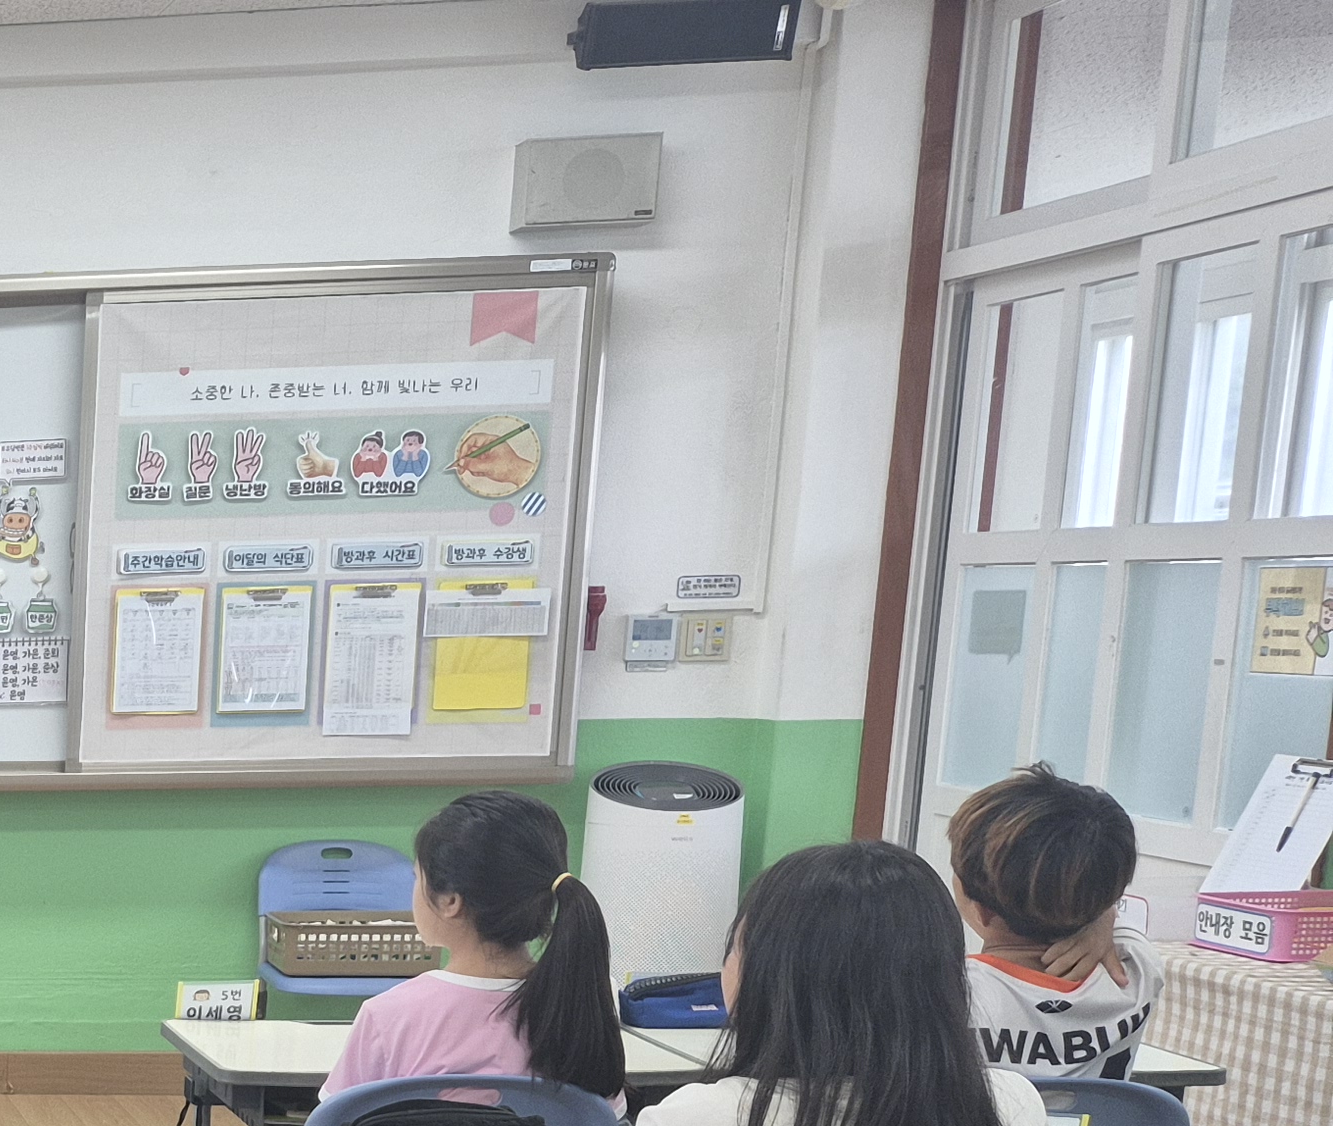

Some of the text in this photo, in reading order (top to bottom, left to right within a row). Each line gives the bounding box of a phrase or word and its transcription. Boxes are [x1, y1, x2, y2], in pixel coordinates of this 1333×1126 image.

[190, 384, 233, 402] 소중한
[268, 381, 325, 399] 존중받는
[360, 379, 389, 396] 함께
[397, 377, 441, 395] 빛나는
[450, 376, 478, 393] 우리
[129, 484, 171, 499] 화장실
[186, 485, 212, 499] 질문
[224, 483, 267, 498] 냉난방
[288, 481, 343, 495] 동의해요
[360, 481, 416, 495] 다했어요
[130, 551, 199, 568] 주간학습안내
[234, 550, 305, 567] 이달의 식단표
[343, 547, 416, 564] 방과후 시간표
[453, 543, 528, 561] 방과후 수강생
[1198, 910, 1268, 945] 안내장 모음
[221, 989, 242, 1001] 5번
[187, 1004, 242, 1020] 이세영
